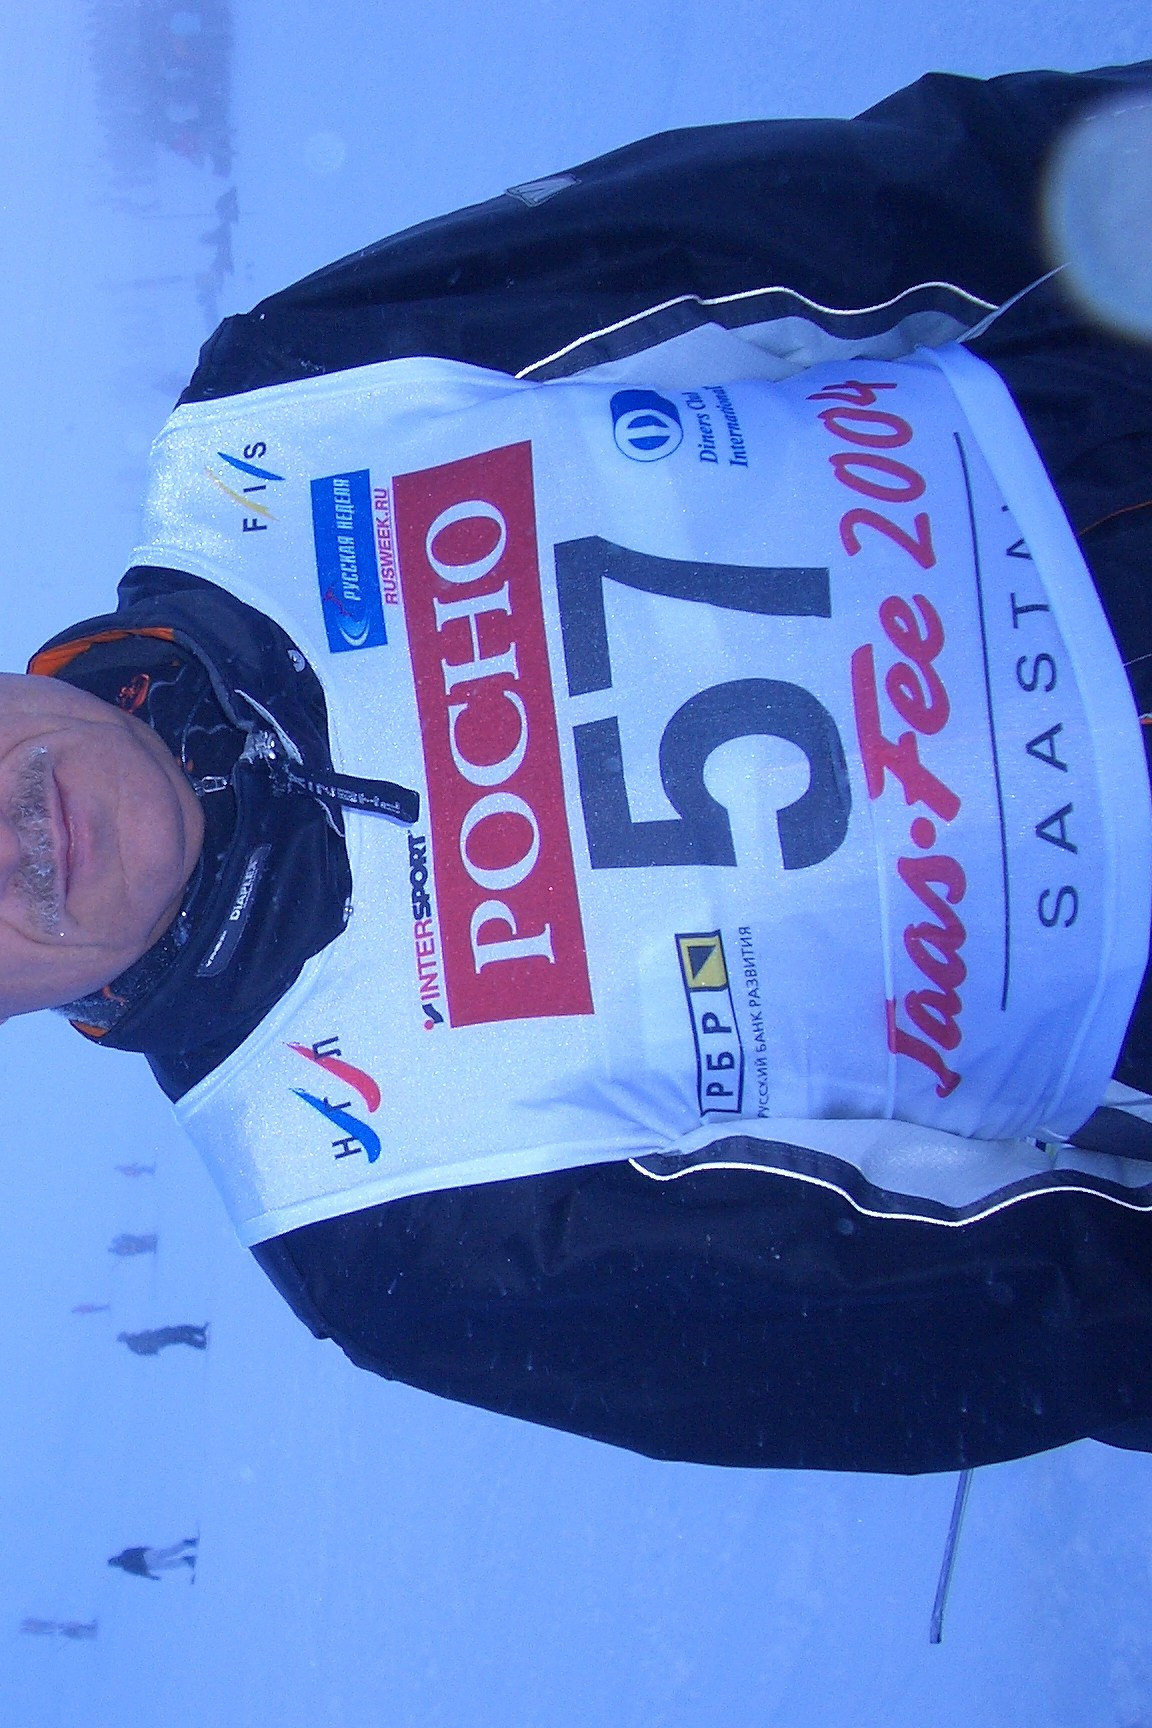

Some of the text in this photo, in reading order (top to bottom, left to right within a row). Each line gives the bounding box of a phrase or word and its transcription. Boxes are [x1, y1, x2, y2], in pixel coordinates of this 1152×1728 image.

[241, 440, 268, 533] FIS
[695, 412, 720, 465] Diners
[700, 385, 749, 469] International
[806, 379, 936, 572] 2004
[332, 477, 362, 602] РУССКАЯ НЕДЕЛЯ
[373, 487, 398, 606] RUSWEEK.RU
[425, 497, 556, 977] РОСНО
[554, 535, 852, 871] 57
[999, 502, 1080, 929] SAASTA
[407, 830, 440, 999] INTERSPORT
[700, 1010, 736, 1098] РБР
[737, 926, 770, 1119] РУССКИЙ БАНК РАЗВИТИЯ
